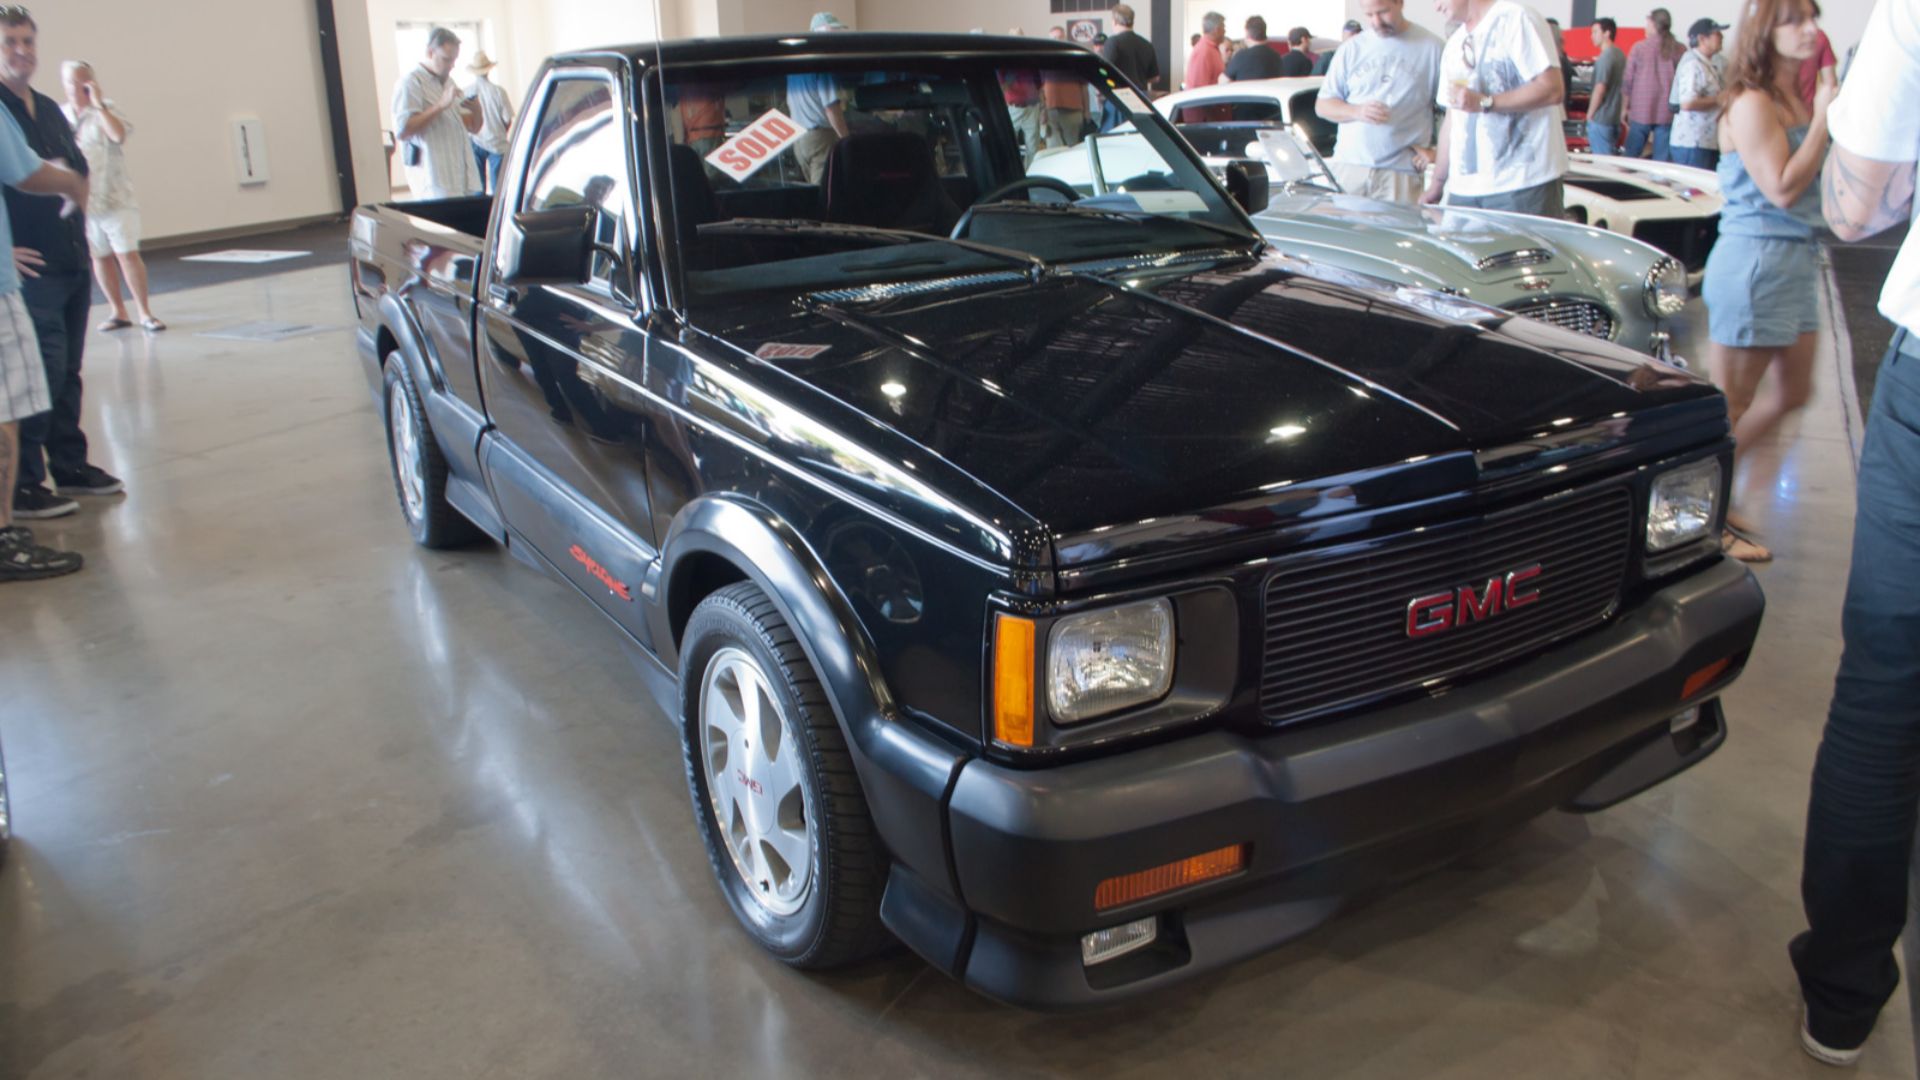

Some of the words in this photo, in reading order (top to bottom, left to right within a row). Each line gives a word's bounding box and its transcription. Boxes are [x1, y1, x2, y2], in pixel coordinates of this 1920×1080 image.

[718, 117, 796, 172] SOLD
[1406, 563, 1543, 638] GMC
[737, 769, 763, 796] GMC
